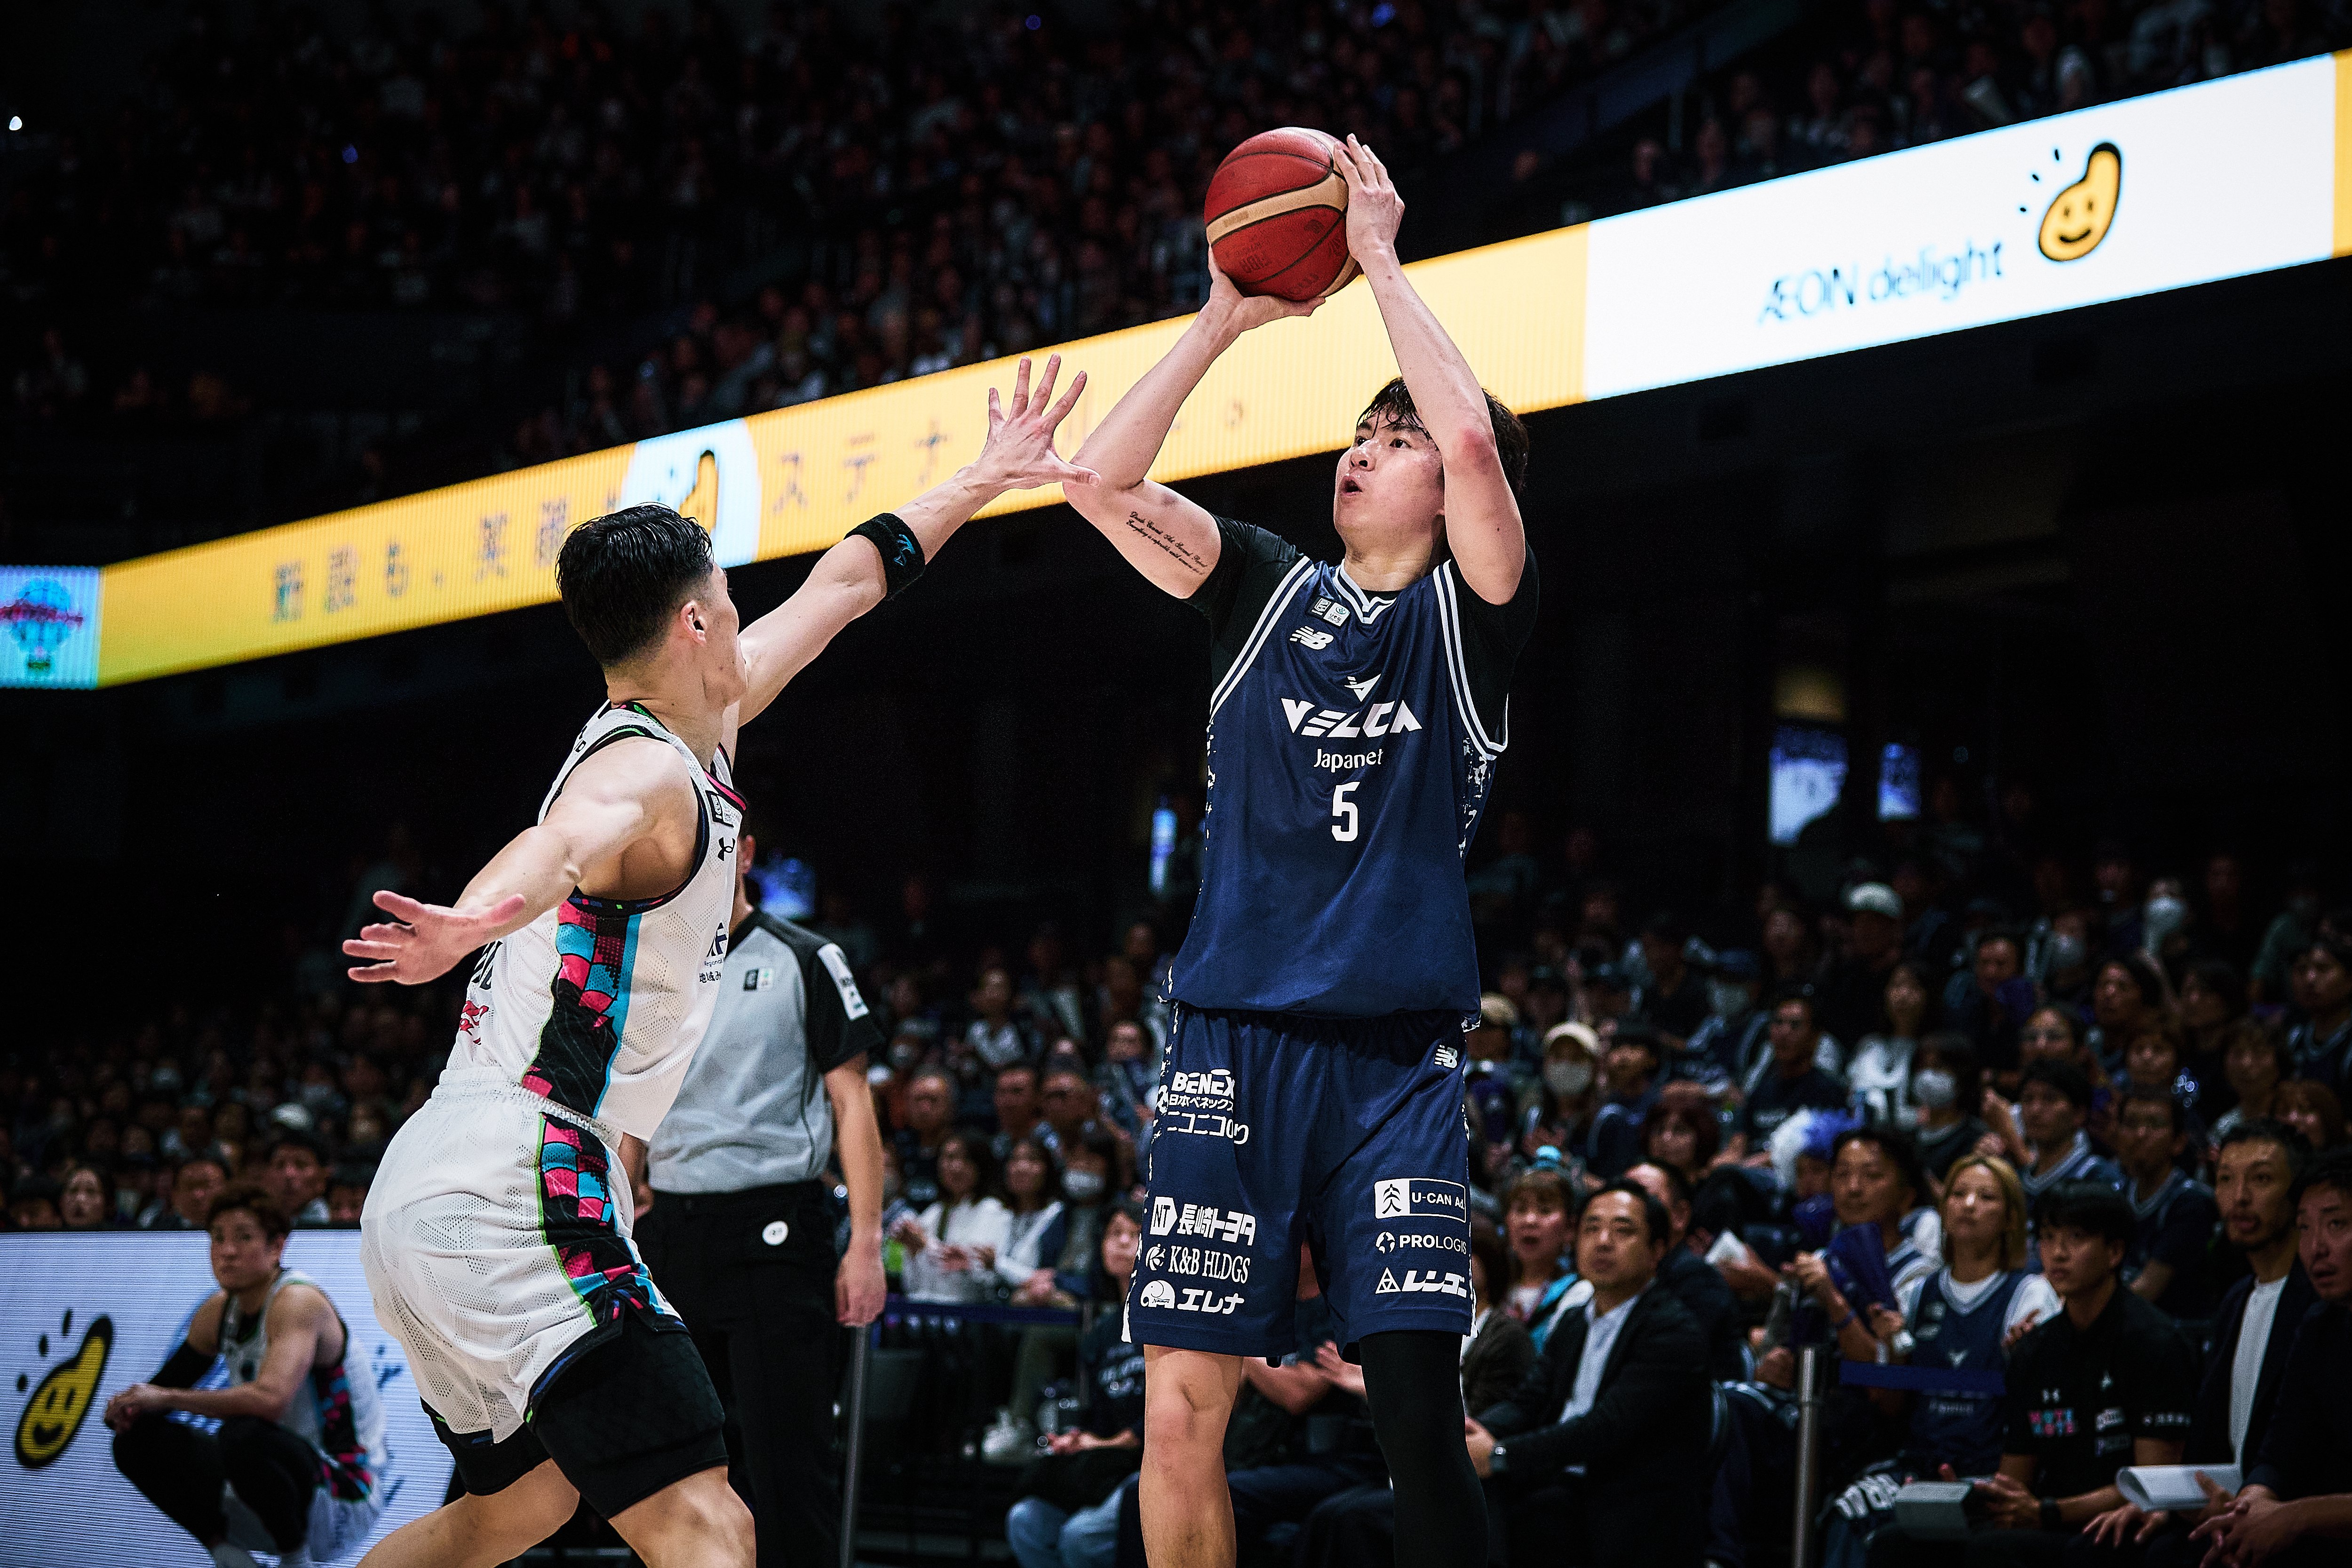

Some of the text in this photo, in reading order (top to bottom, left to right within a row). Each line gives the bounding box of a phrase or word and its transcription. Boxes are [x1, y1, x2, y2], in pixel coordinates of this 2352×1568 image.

[1313, 748, 1383, 773] Japanet
[1331, 781, 1360, 842] 5
[1412, 1192, 1452, 1206] U-CAN
[1153, 1204, 1171, 1228] NT
[1176, 1203, 1256, 1246] 長崎トヨタ
[1399, 1234, 1467, 1255] PROLOGIS
[1168, 1245, 1250, 1284] K&B HLDGS
[1177, 1288, 1245, 1314] エレナ
